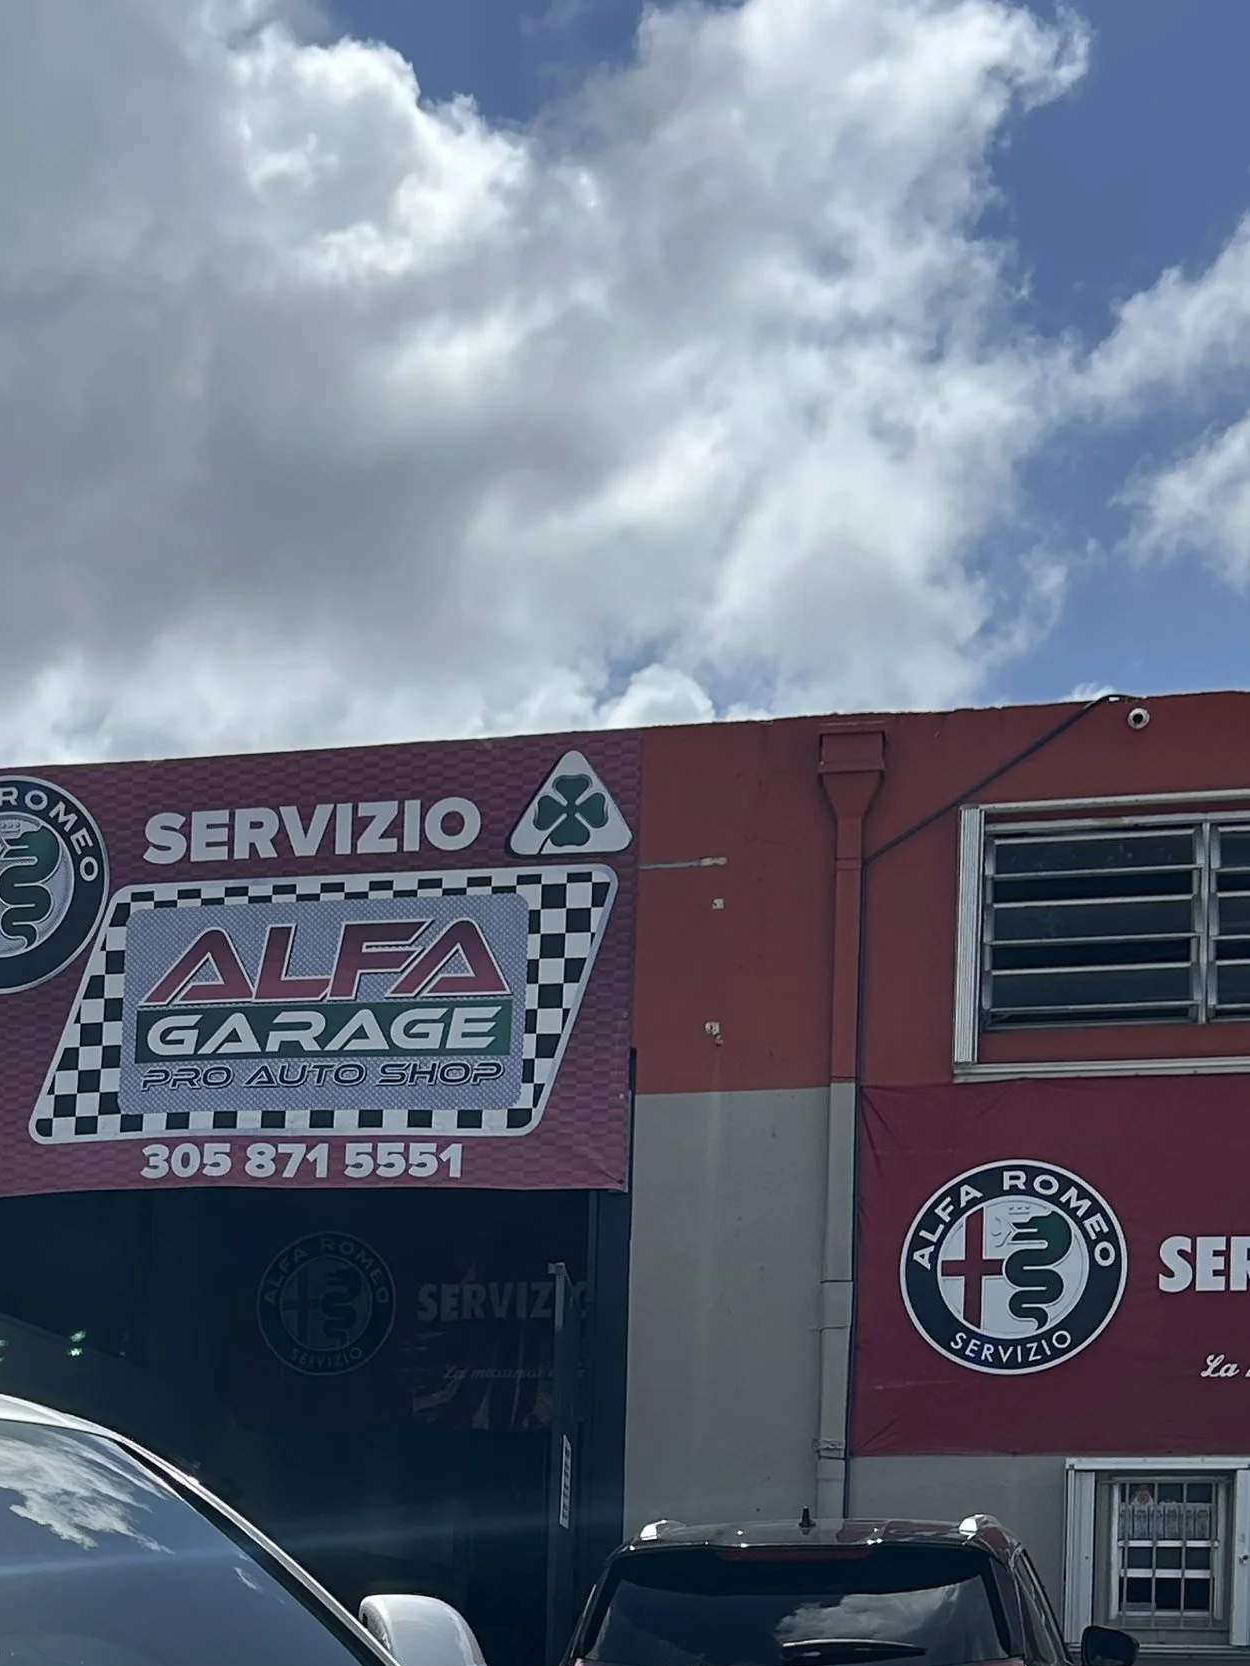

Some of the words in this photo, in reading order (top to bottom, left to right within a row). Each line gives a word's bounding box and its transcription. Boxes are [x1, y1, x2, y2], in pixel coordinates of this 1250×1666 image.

[142, 796, 482, 865] SERVIZIO
[138, 917, 512, 1007] ALFA
[146, 1005, 503, 1056] GARAGE
[140, 1065, 235, 1091] PRO
[243, 1062, 368, 1089] AUTO
[375, 1060, 505, 1086] SHOP
[139, 1142, 233, 1179] 305
[245, 1142, 329, 1178] 871
[343, 1142, 463, 1179] 5551
[912, 1184, 984, 1270] ALFA
[1002, 1170, 1116, 1267] ROMEO
[264, 1248, 309, 1307] ALFA
[320, 1238, 389, 1303] ROMEO
[288, 1347, 362, 1369] SERVIZIO
[950, 1330, 1072, 1364] SERVIZIO
[1200, 1354, 1240, 1377] La
